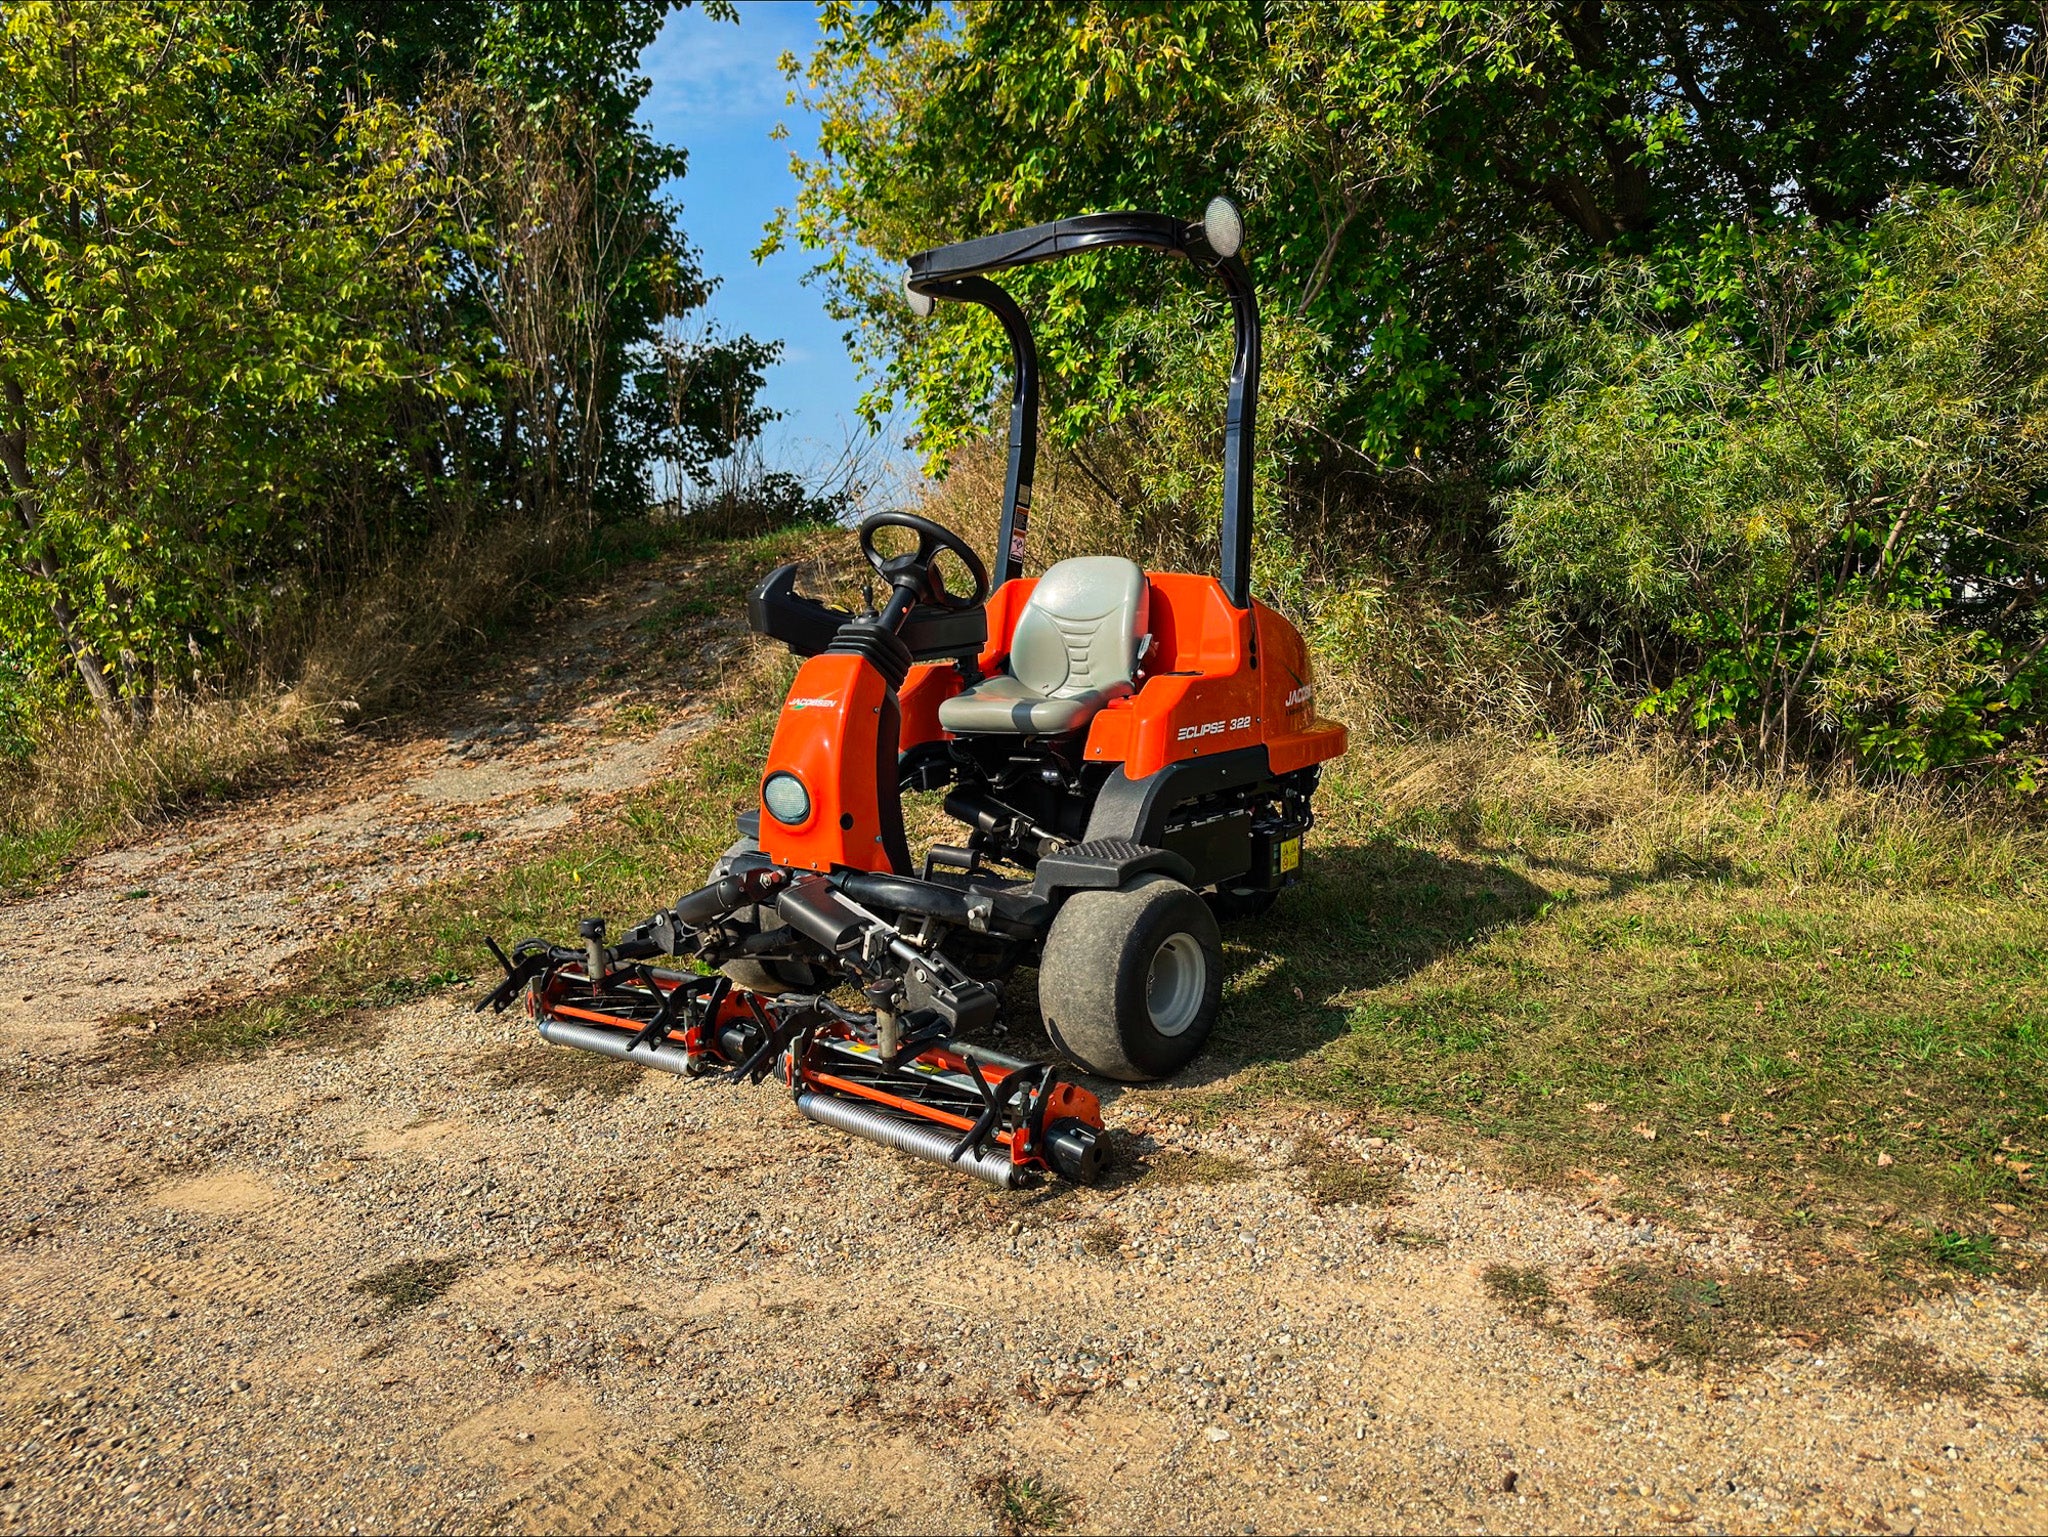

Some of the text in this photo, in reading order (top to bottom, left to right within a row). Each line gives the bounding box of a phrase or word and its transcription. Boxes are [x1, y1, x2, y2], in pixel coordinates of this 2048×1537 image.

[788, 698, 838, 707] JACOBSEN
[1177, 716, 1251, 741] ECLIPSE 322
